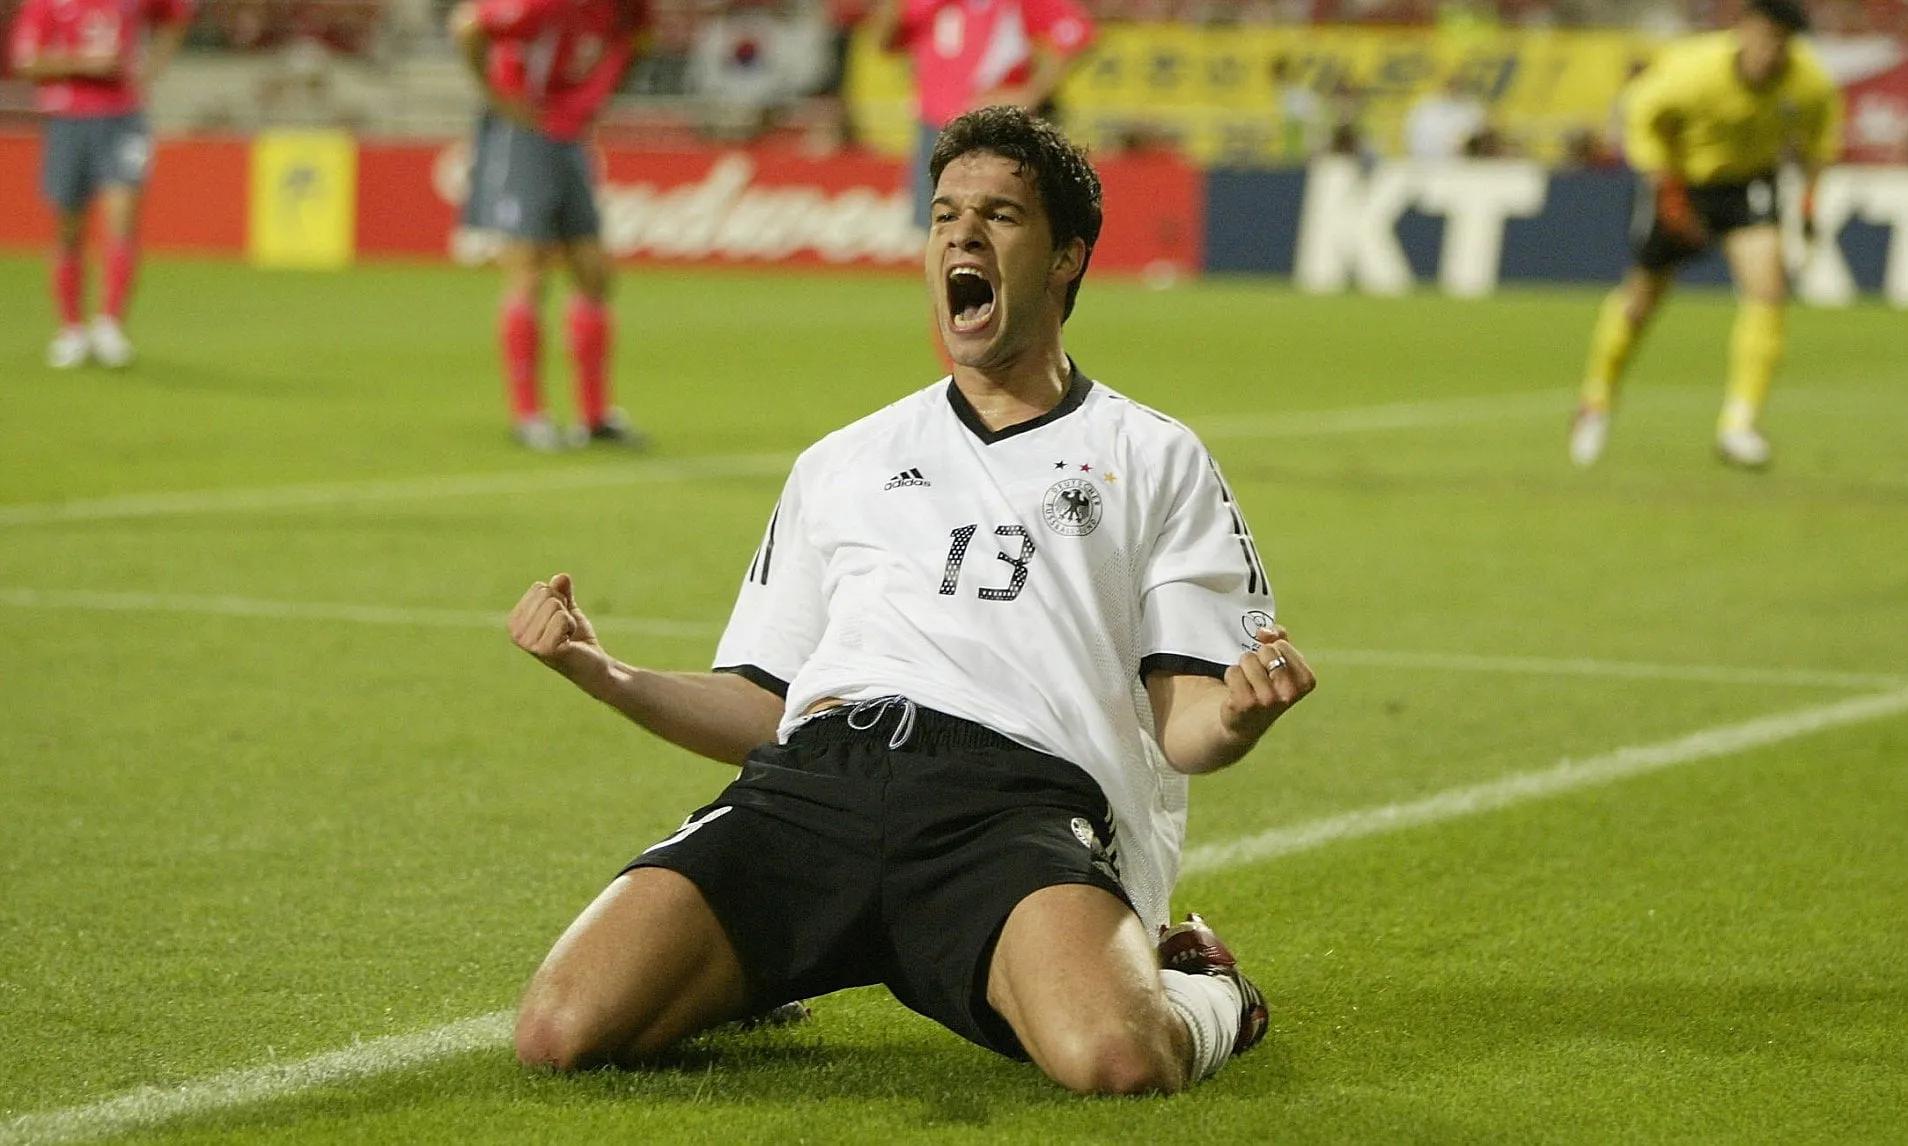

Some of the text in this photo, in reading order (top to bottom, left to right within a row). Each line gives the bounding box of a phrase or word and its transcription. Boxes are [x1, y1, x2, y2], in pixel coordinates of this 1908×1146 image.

[1299, 156, 1549, 297] KT
[884, 479, 931, 491] adidas
[938, 523, 1036, 601] 13
